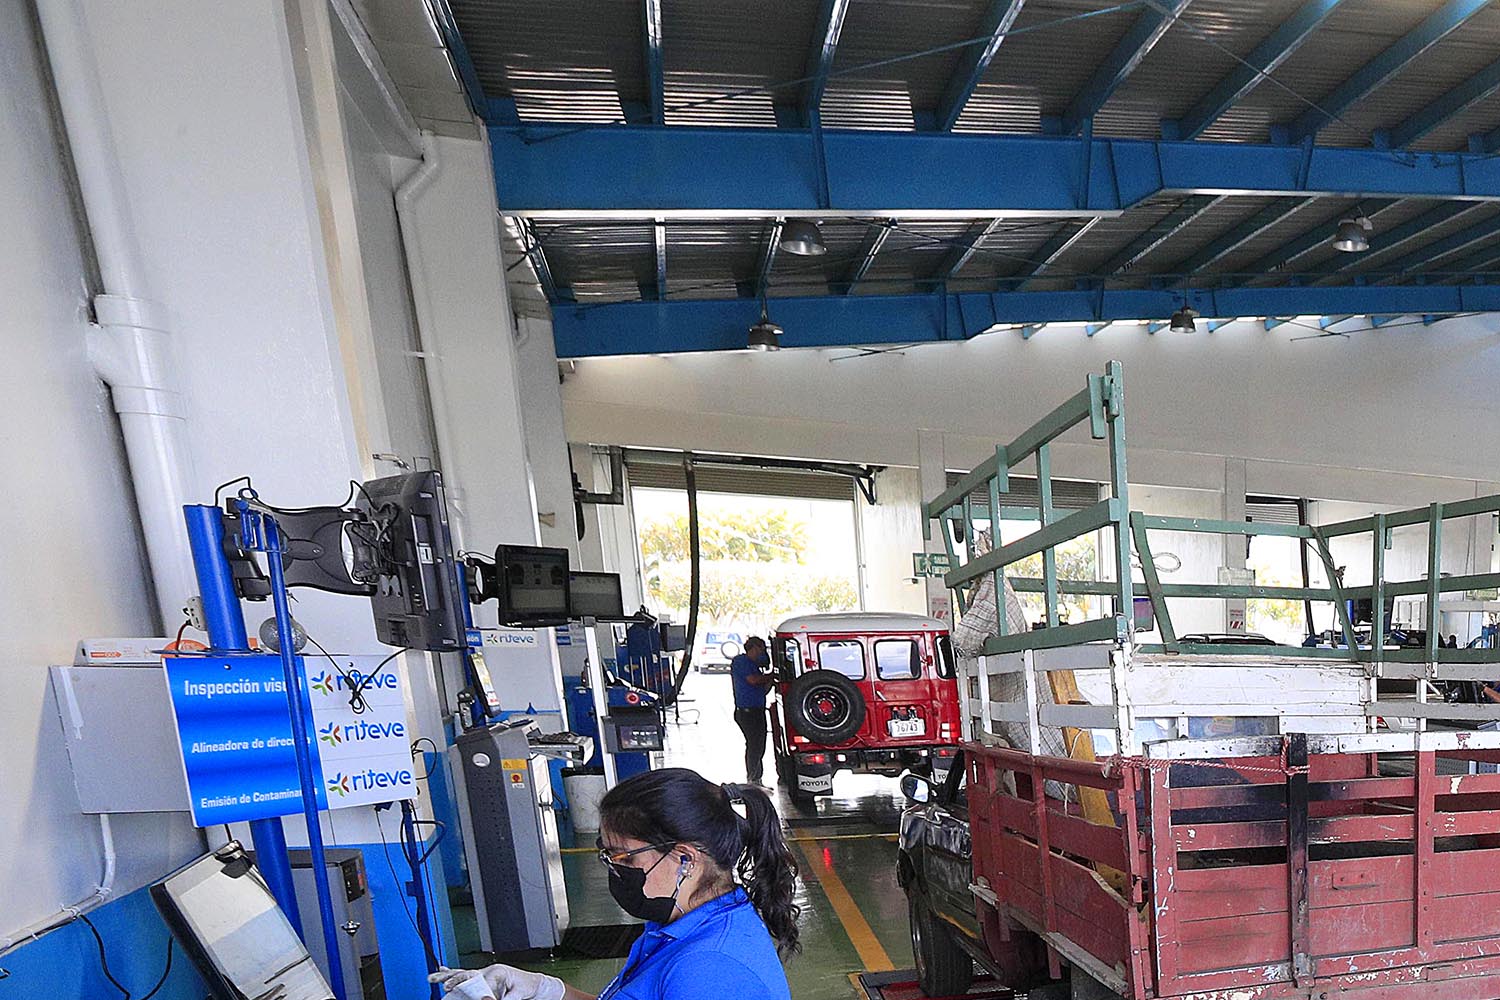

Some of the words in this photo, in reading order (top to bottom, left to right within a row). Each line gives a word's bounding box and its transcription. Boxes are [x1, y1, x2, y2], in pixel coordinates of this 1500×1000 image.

[184, 679, 260, 699] Inspección
[343, 720, 405, 742] riteve
[192, 741, 248, 753] Alineadora
[252, 739, 264, 748] de
[352, 769, 412, 791] riteve
[201, 796, 237, 809] Emisión
[240, 794, 251, 804] de
